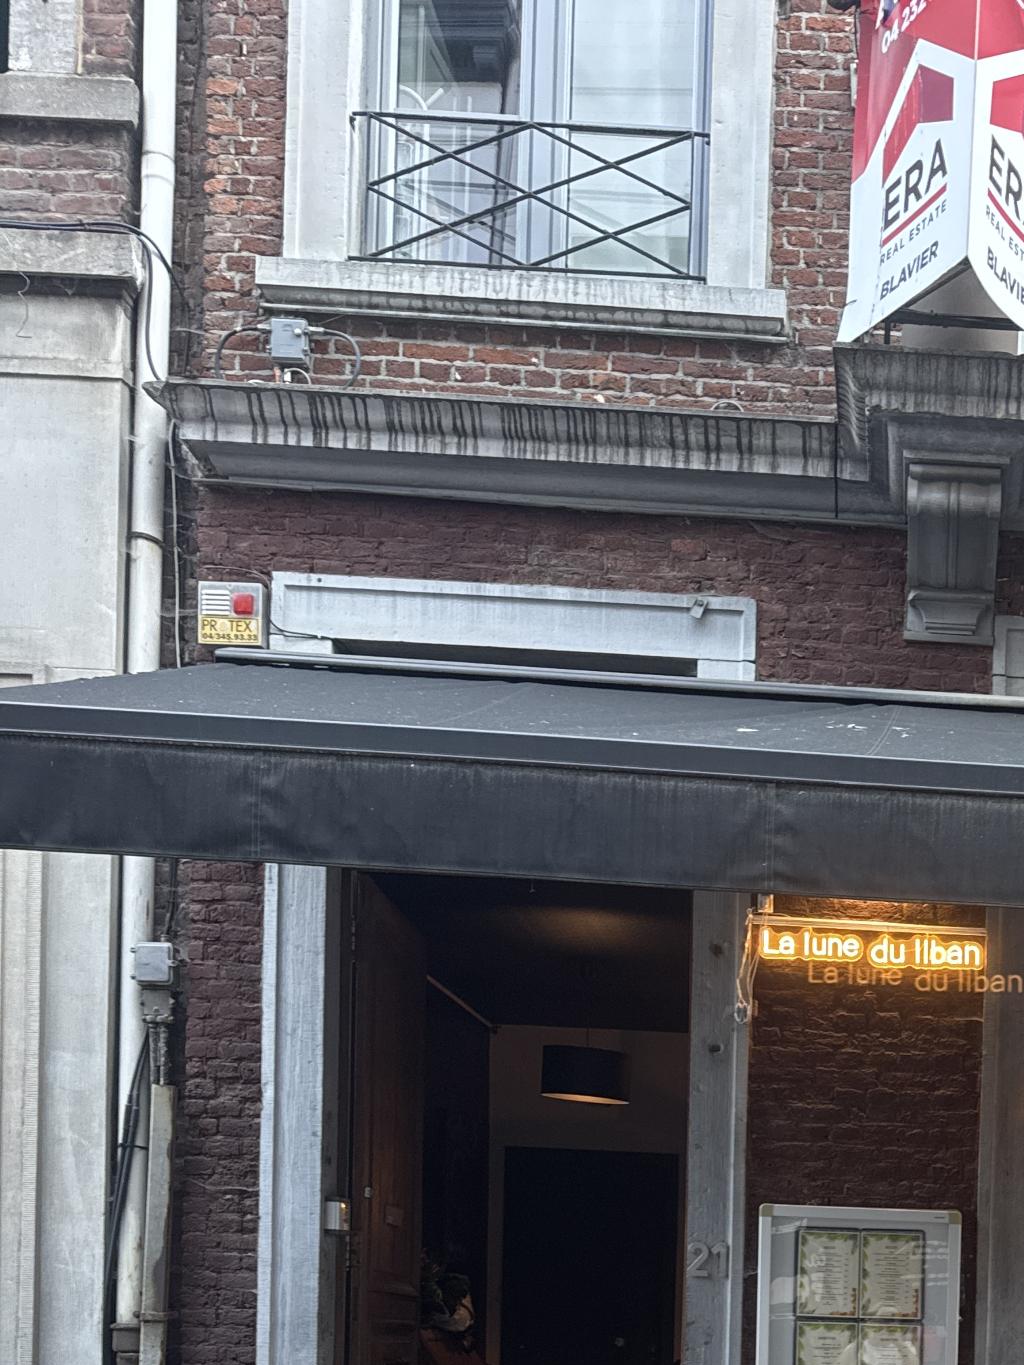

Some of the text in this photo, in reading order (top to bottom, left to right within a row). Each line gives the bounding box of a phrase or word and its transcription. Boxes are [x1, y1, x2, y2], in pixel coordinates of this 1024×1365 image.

[883, 138, 947, 231] ERA
[880, 199, 947, 266] REAL ESTATE
[986, 205, 1006, 240] REAL
[880, 240, 939, 301] BLAVIER
[202, 619, 252, 632] PRTEX
[762, 928, 981, 966] La lune du liban
[687, 1242, 728, 1278] 21
